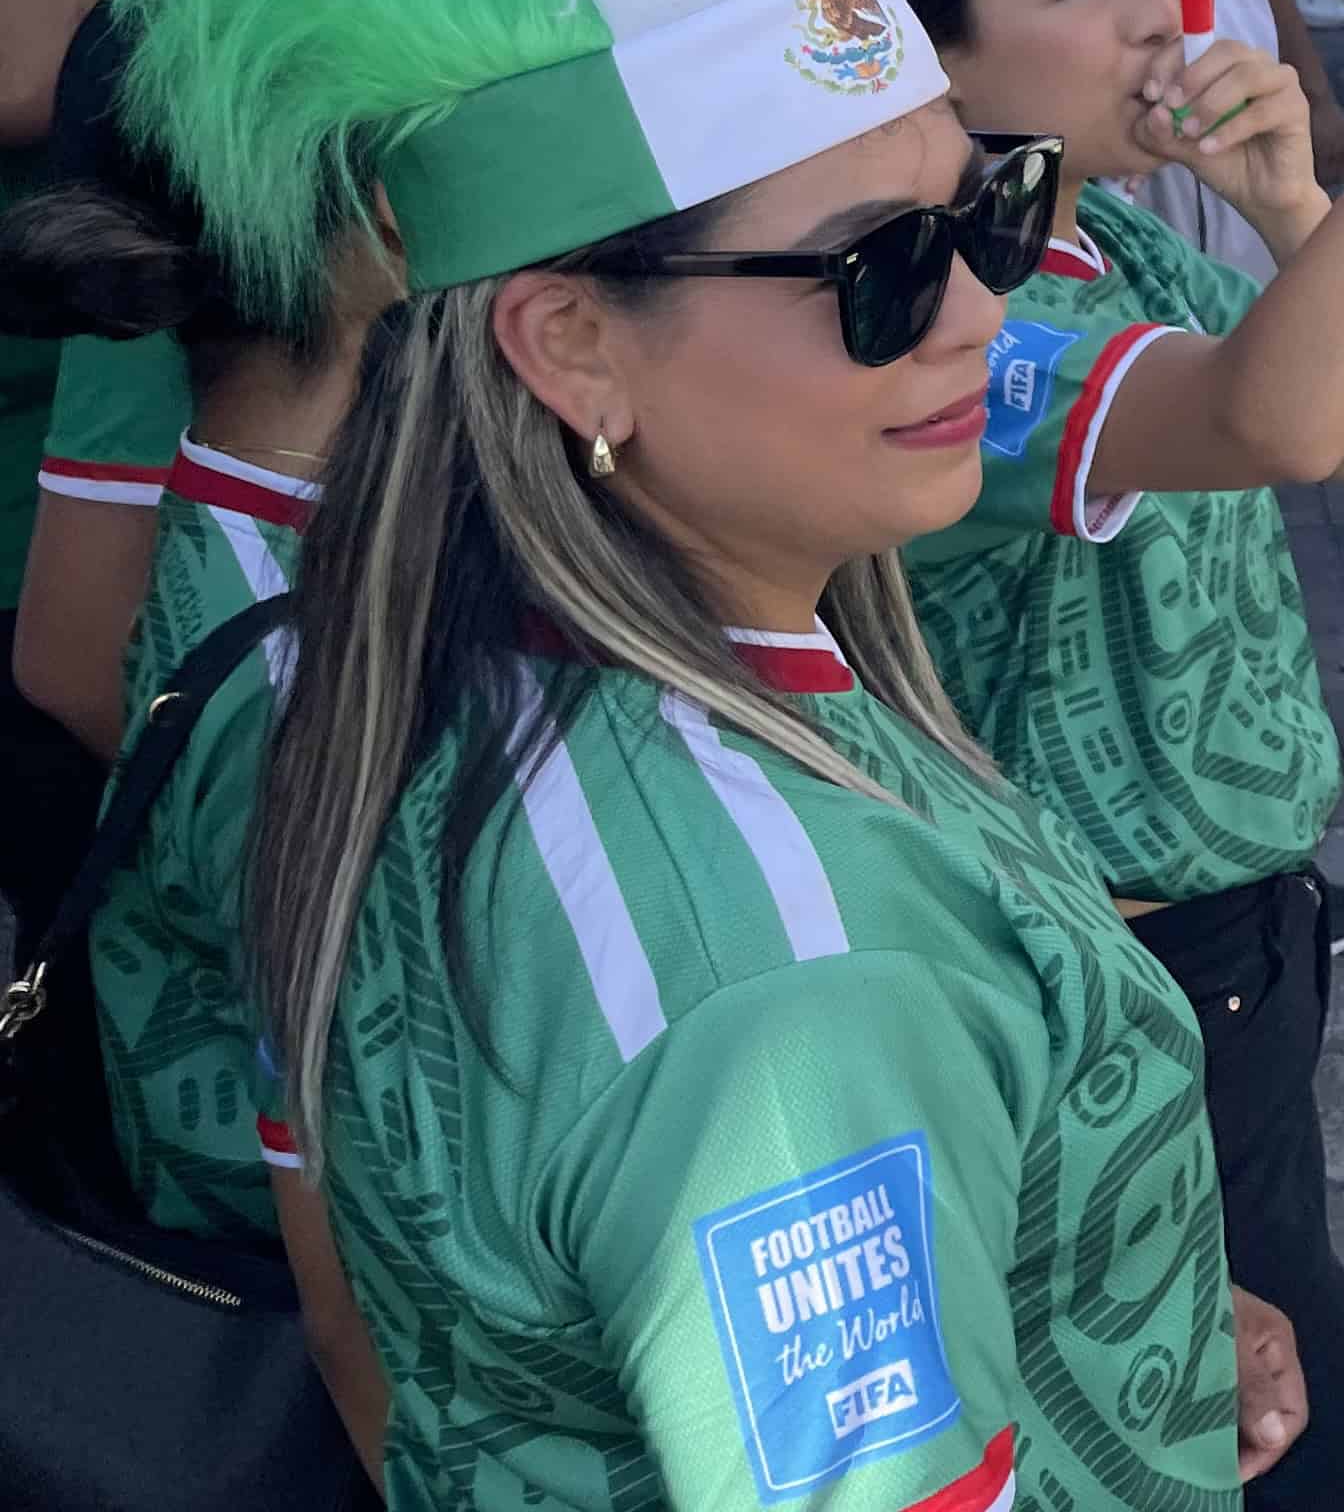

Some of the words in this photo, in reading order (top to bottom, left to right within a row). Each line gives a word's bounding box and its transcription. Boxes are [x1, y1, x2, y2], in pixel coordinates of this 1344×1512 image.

[1009, 362, 1031, 409] FIFA
[750, 1184, 895, 1278] FOOTBALL
[757, 1225, 910, 1334] UNITES
[776, 1335, 834, 1386] the
[837, 1280, 926, 1360] World
[834, 1368, 914, 1429] FIFA
